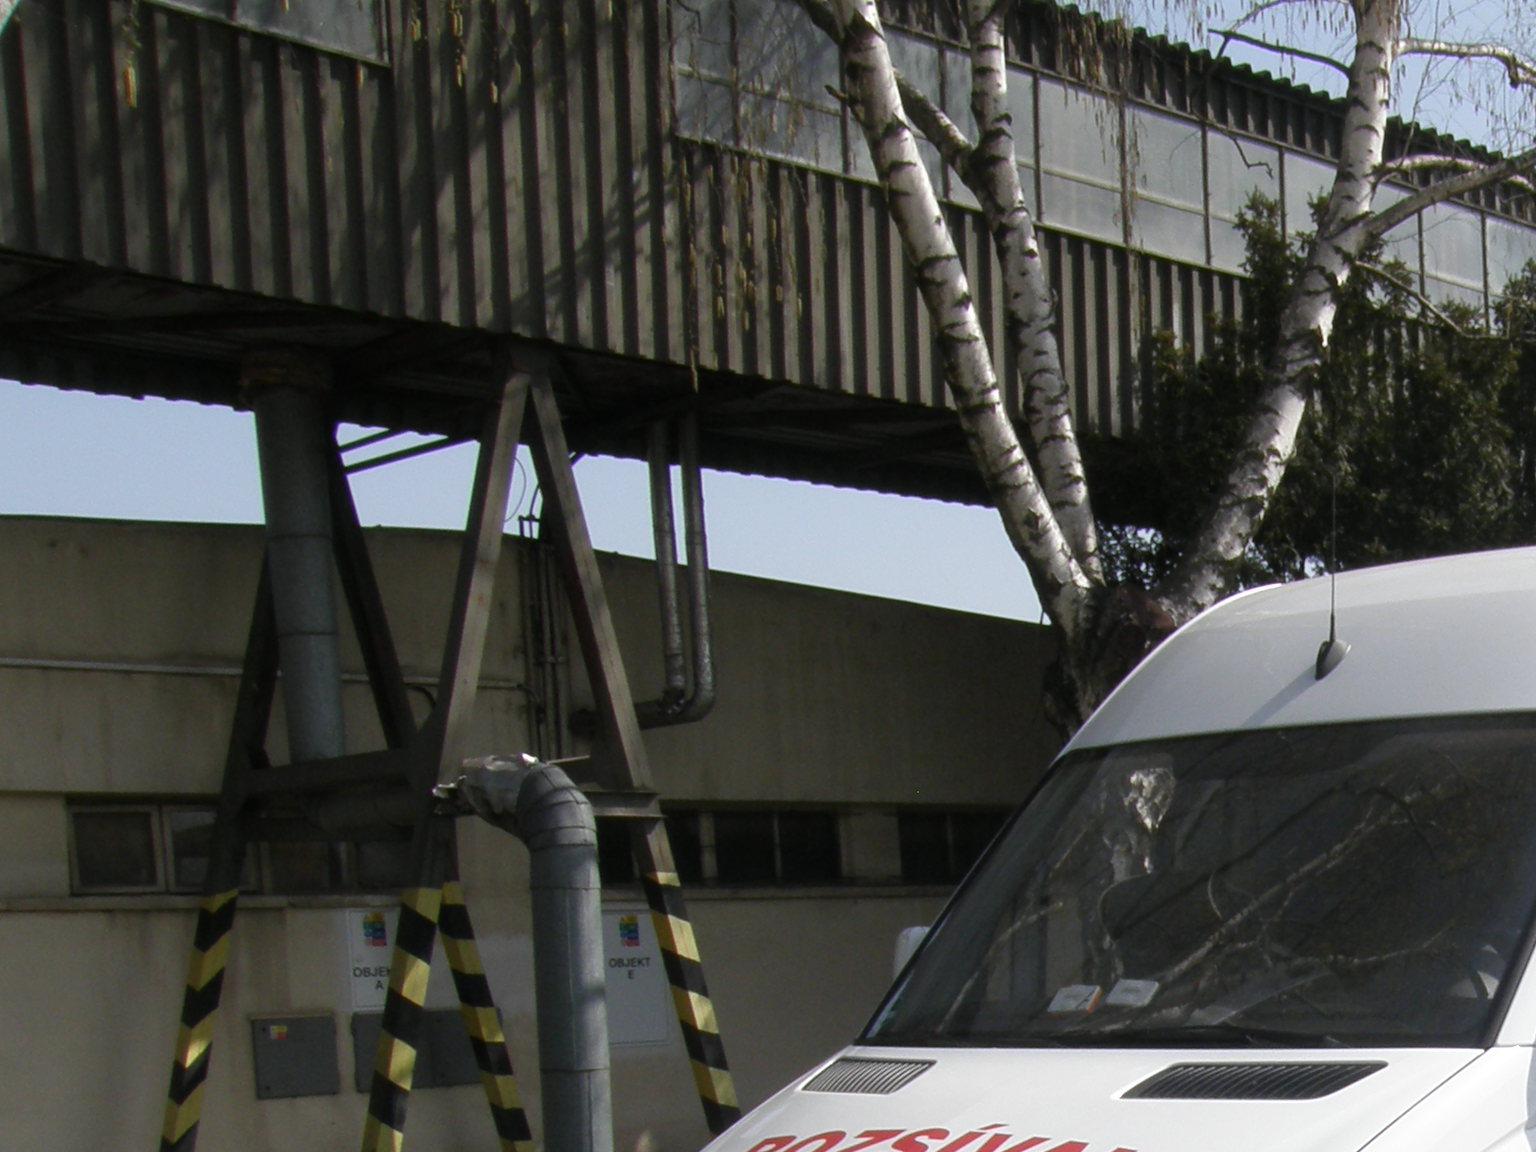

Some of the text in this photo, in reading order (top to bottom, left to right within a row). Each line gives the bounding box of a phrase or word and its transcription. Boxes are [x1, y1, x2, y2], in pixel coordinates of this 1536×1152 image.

[608, 957, 651, 968] OBJEKT
[627, 969, 635, 979] E
[375, 980, 384, 989] A
